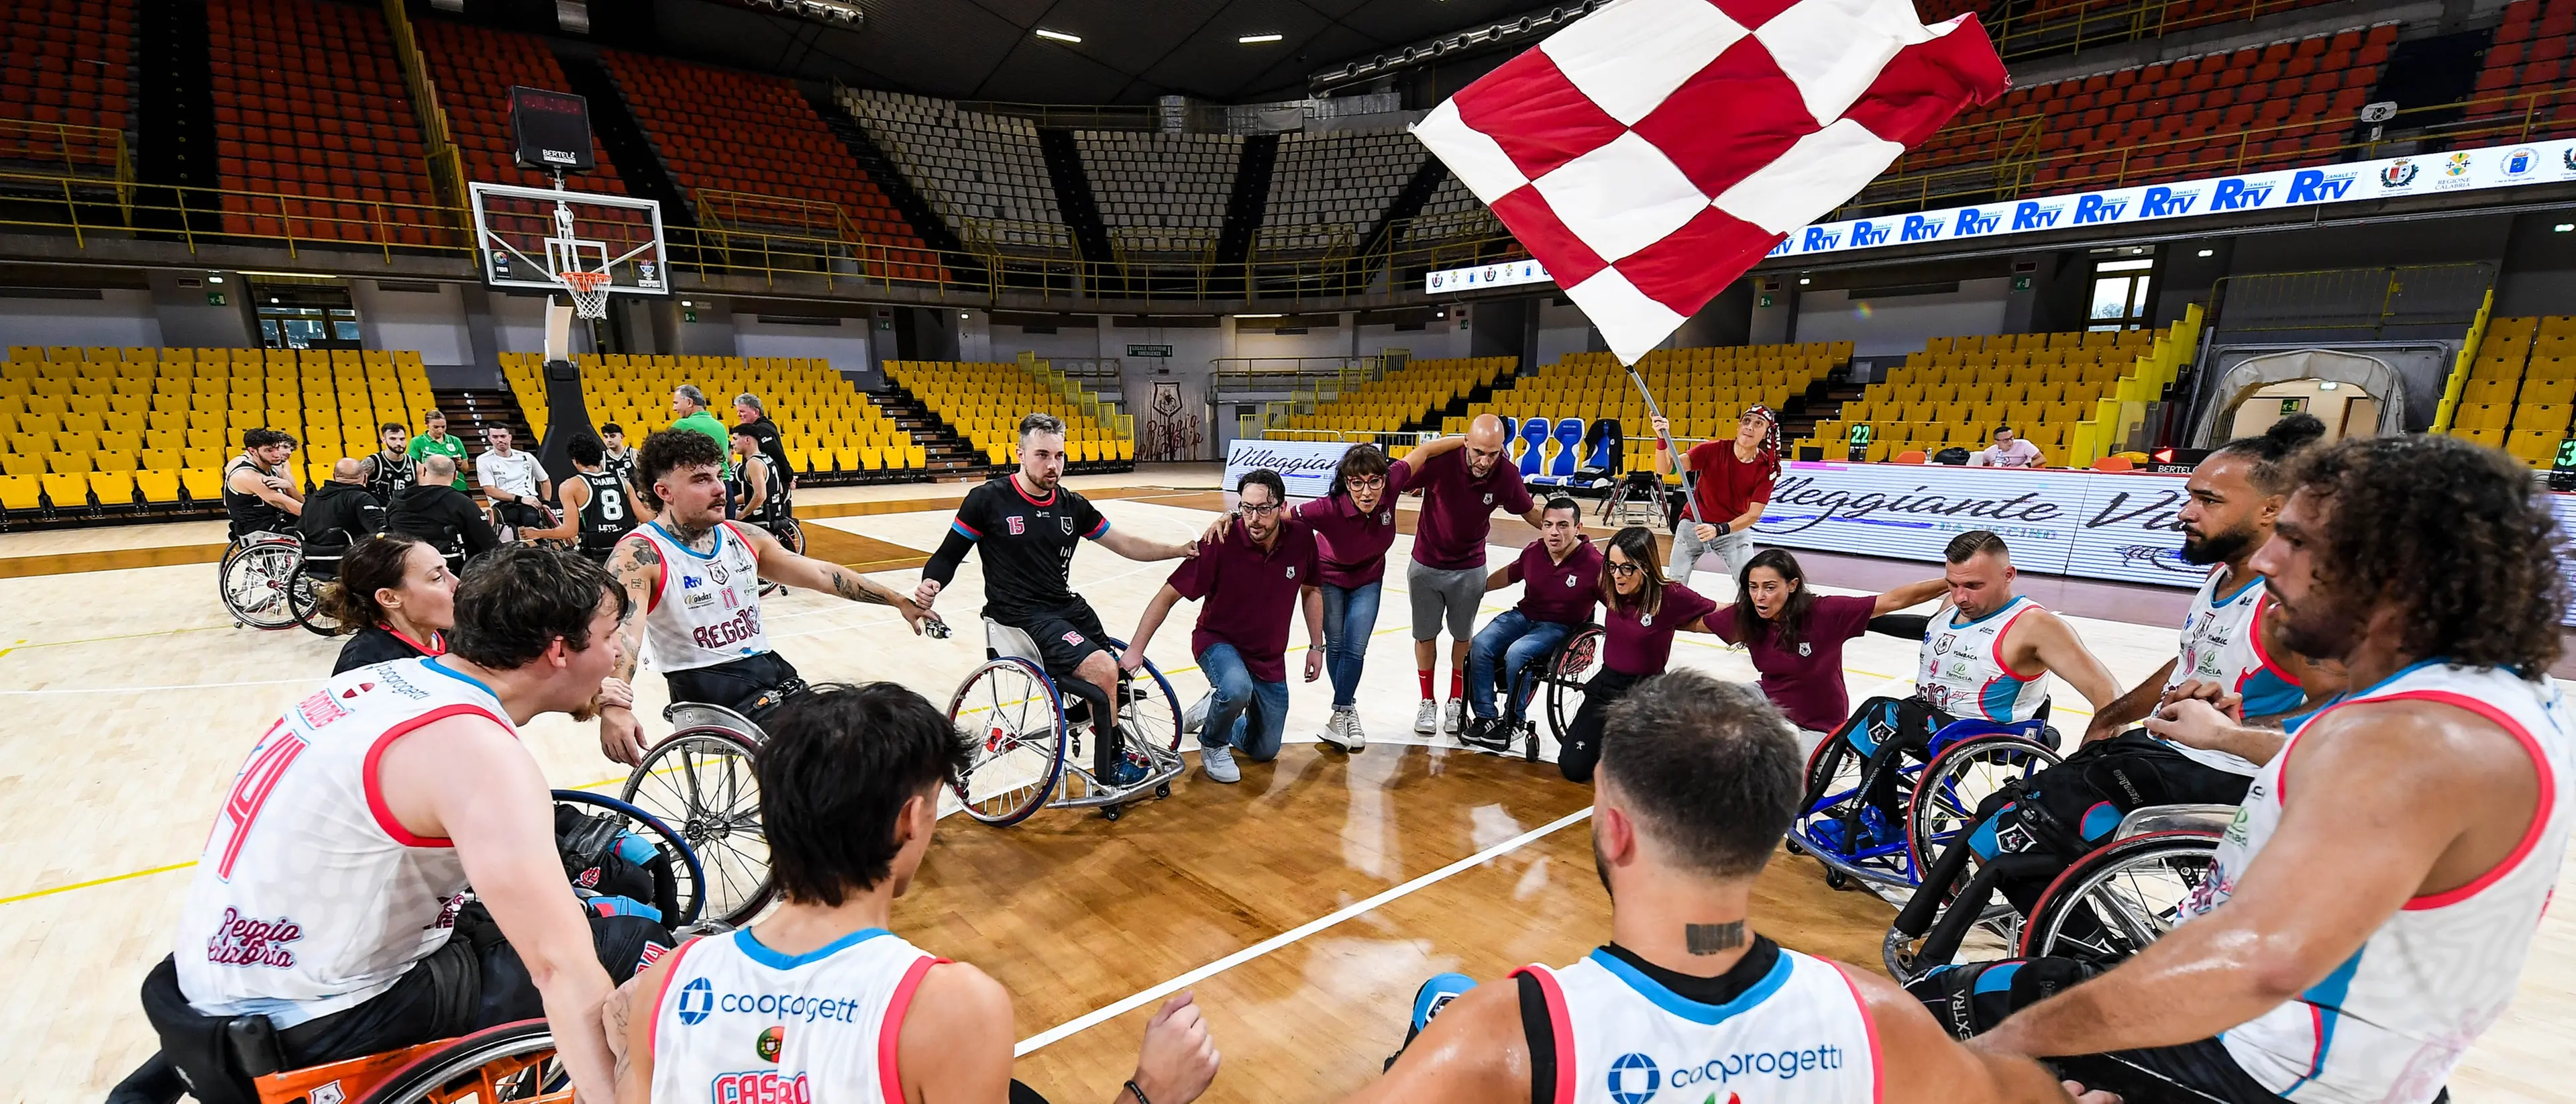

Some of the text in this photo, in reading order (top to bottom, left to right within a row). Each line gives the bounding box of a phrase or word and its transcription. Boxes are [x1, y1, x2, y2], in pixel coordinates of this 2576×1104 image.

[2437, 177, 2471, 185] REGIONE
[1851, 425, 1870, 443] 22
[394, 479, 405, 491] 16
[600, 489, 624, 521] 8
[1750, 477, 2065, 534] lleggiante
[1006, 515, 1026, 535] 15
[719, 586, 739, 610] 11
[1062, 630, 1085, 646] 15
[1953, 650, 1978, 660] YUMBACA
[1953, 989, 1974, 1040] EXTRA
